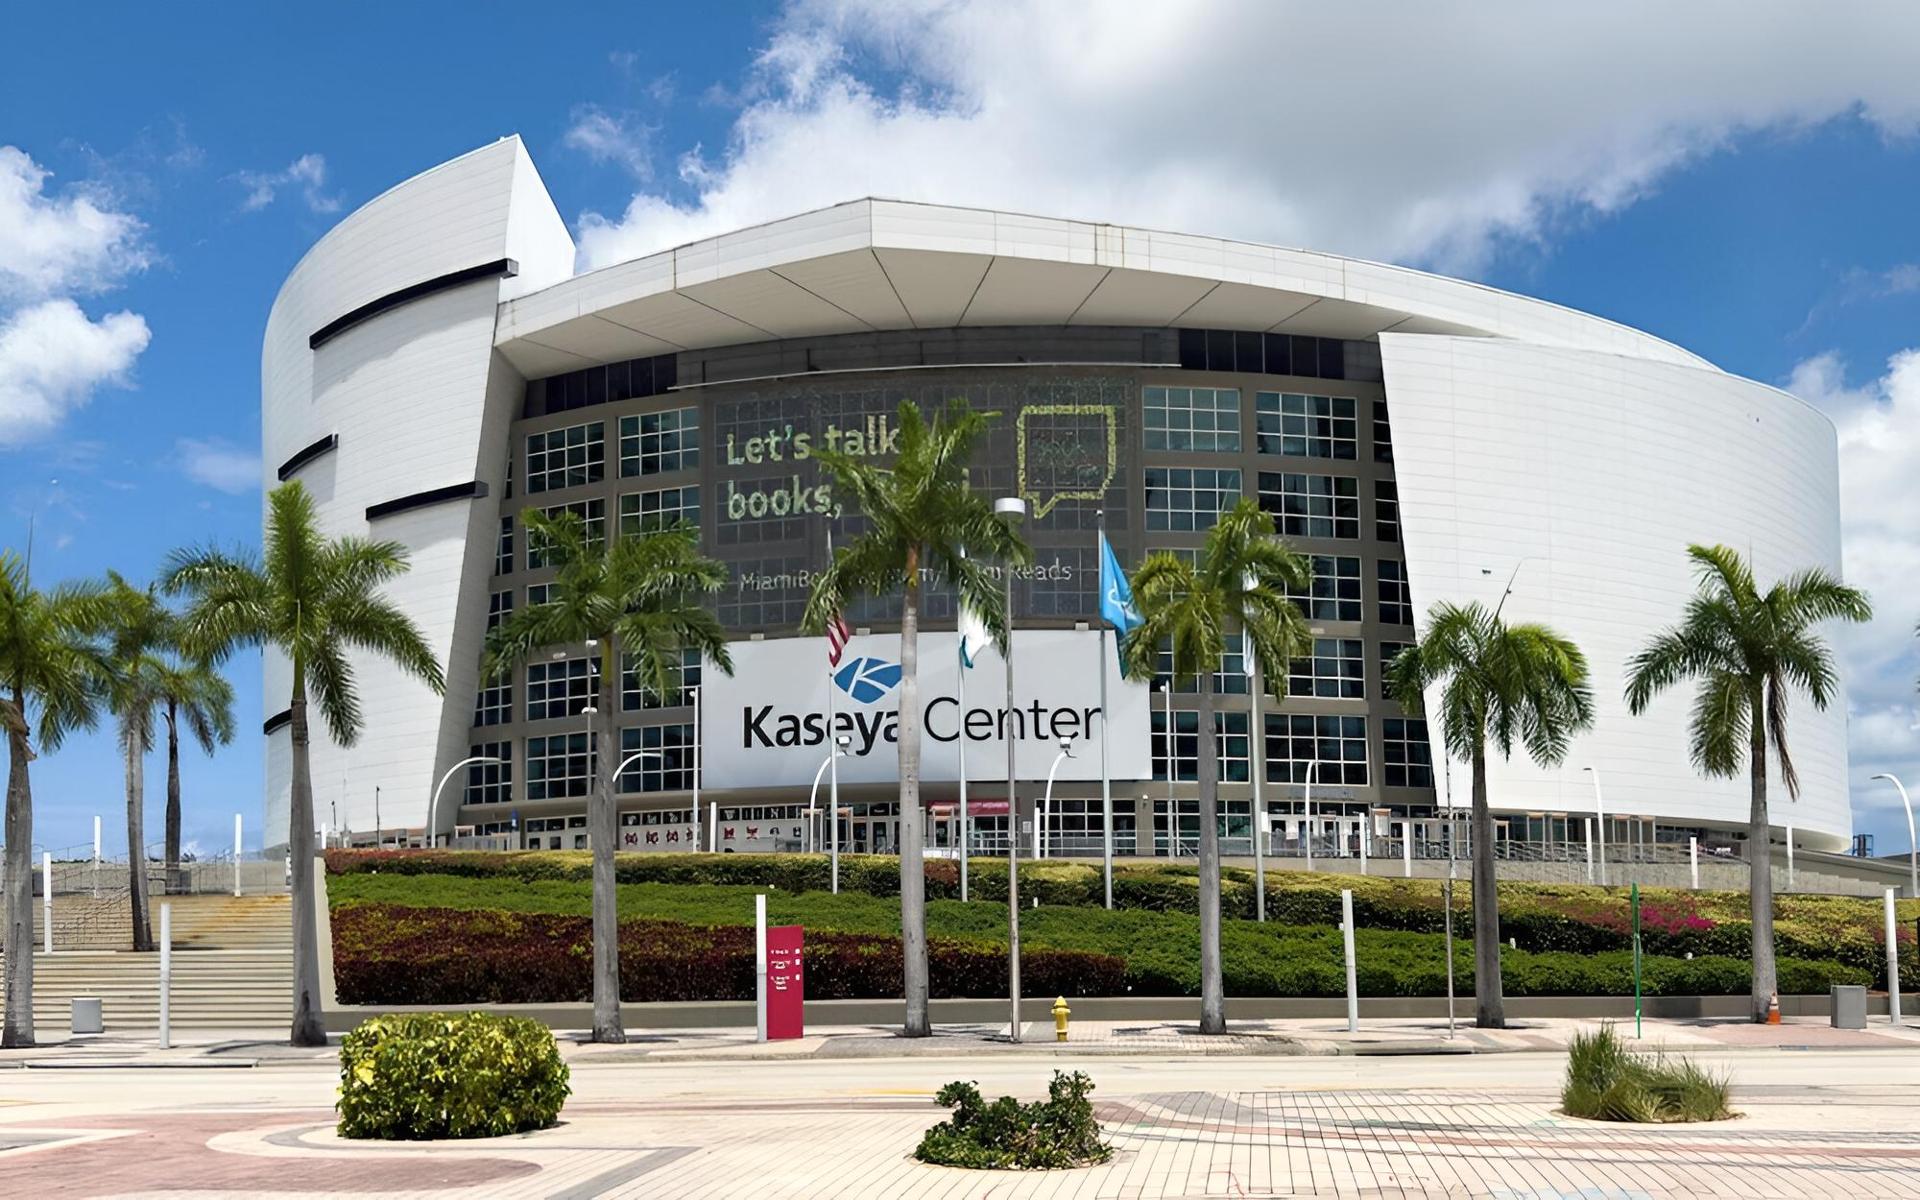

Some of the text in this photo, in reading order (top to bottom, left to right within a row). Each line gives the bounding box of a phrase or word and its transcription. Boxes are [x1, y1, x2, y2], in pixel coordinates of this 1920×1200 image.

[727, 415, 900, 466] Let's talk
[728, 474, 842, 520] books,
[743, 696, 1102, 756] Kaseya Center
